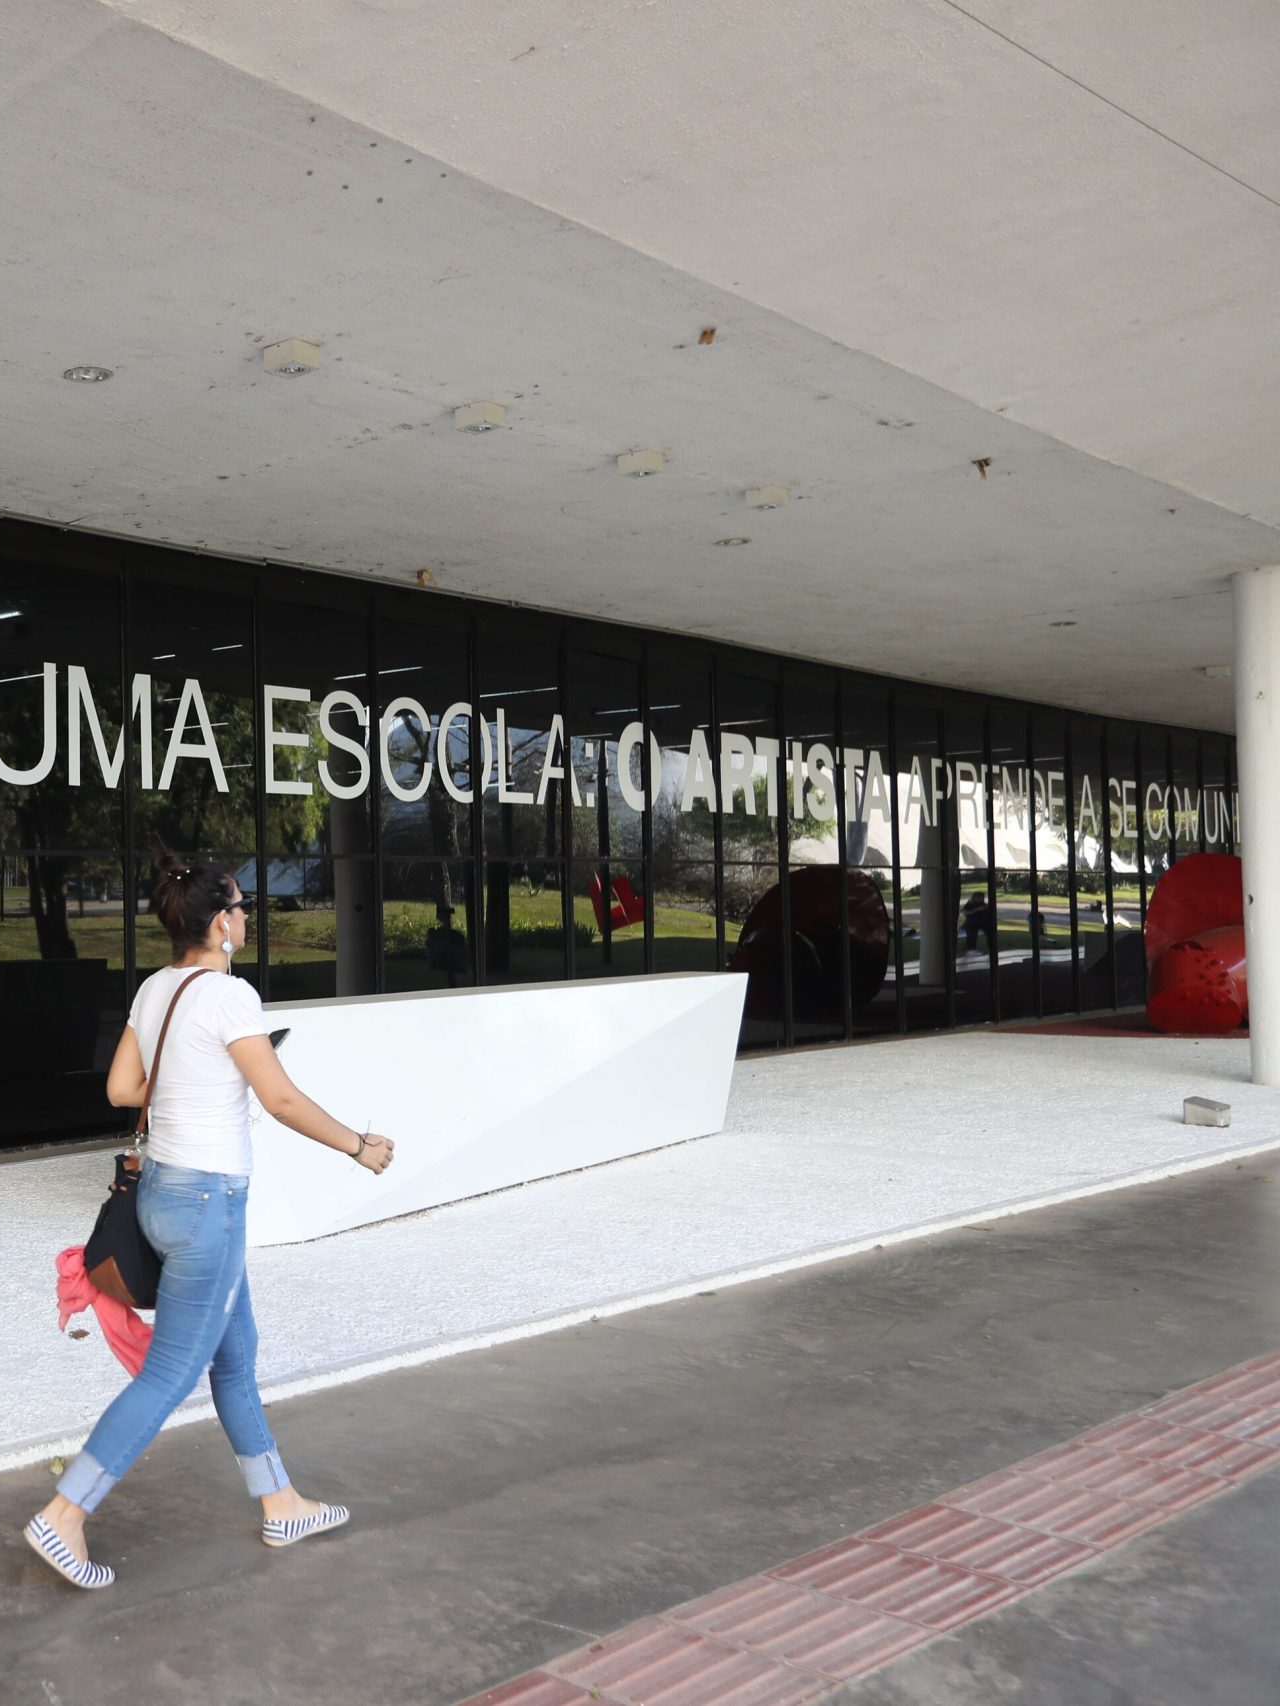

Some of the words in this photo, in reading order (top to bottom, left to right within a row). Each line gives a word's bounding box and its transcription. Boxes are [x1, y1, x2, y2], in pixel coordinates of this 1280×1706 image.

[264, 685, 595, 808] ESCOLA:
[617, 722, 661, 812] O
[680, 729, 892, 823] ARTISTA
[904, 756, 1064, 832] APRENDE
[1079, 775, 1098, 835] A
[1108, 777, 1138, 838] SE
